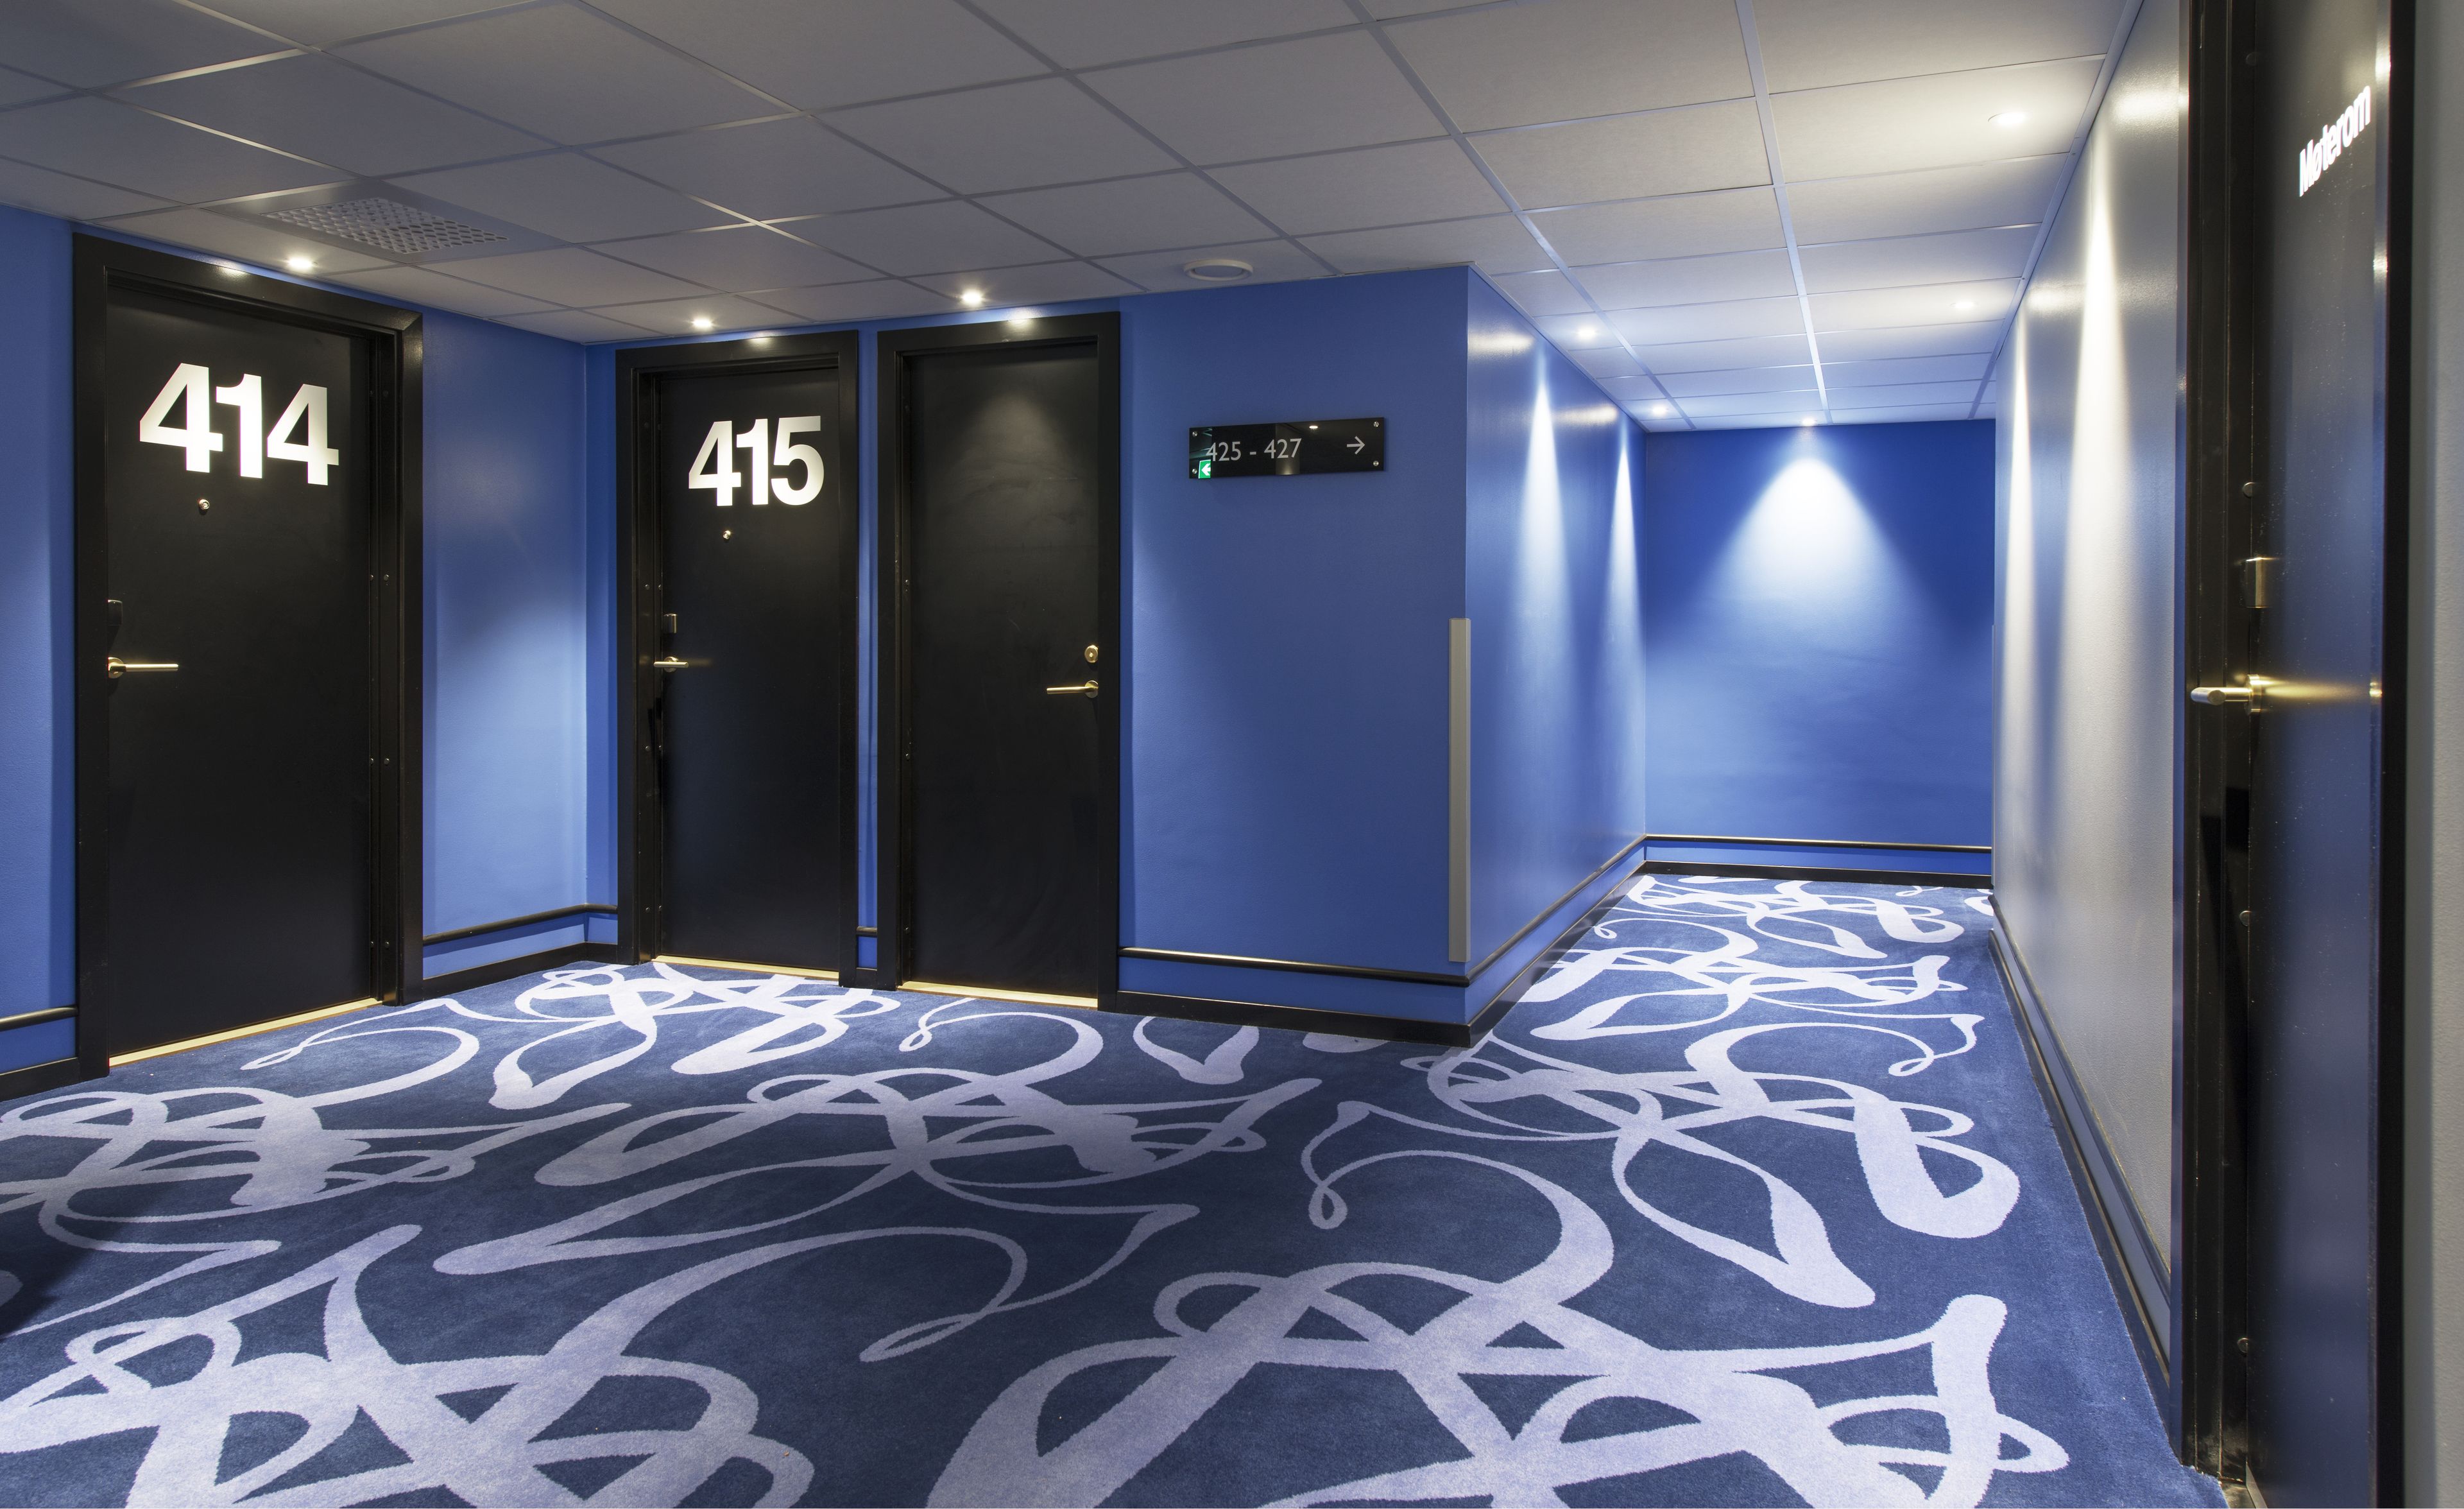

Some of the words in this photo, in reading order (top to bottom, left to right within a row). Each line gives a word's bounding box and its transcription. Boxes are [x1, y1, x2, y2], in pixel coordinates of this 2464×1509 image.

[2299, 85, 2371, 197] Møterom
[139, 362, 339, 487] 414
[688, 415, 825, 506] 415
[1206, 441, 1242, 461] 425
[1263, 438, 1303, 460] 427
